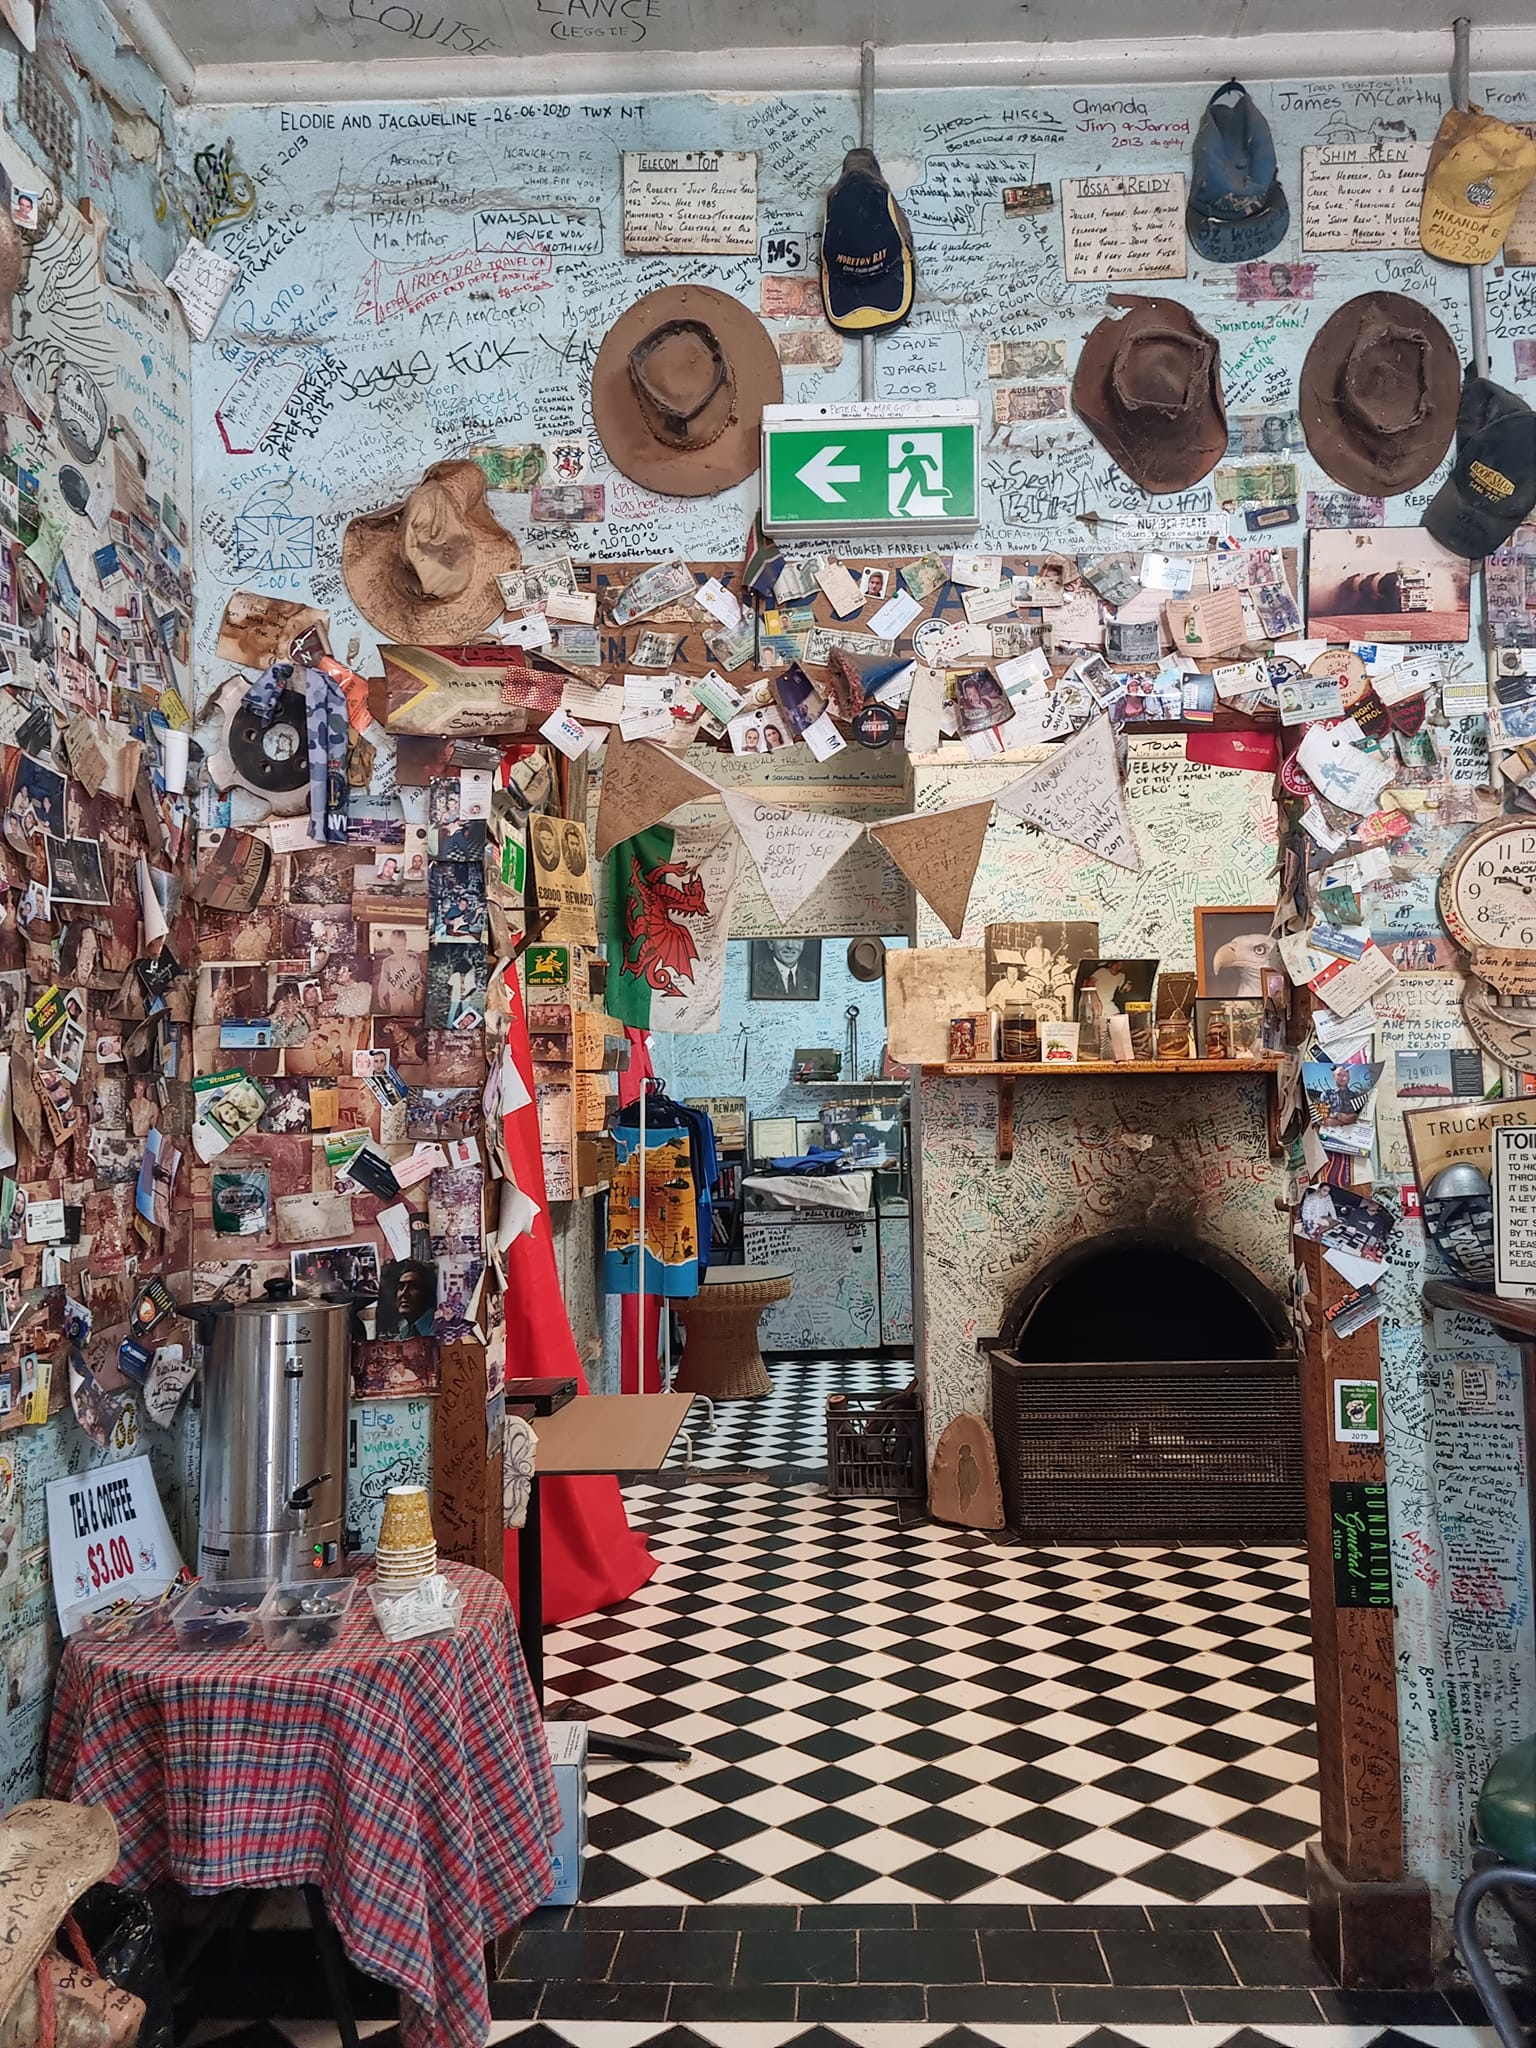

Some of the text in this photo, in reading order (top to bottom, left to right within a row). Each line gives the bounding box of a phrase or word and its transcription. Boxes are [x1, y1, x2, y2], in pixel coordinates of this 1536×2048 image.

[1280, 92, 1341, 112] James
[281, 111, 334, 130] ELODIE
[341, 111, 371, 129] AND
[378, 109, 477, 130] JACQUELINE
[1112, 137, 1143, 147] 2013
[482, 213, 560, 228] WALSALL
[506, 229, 584, 241] NEVER WON
[887, 337, 941, 350] JANE
[448, 337, 529, 375] FUCK
[886, 383, 936, 395] 2008
[1358, 708, 1382, 729] ATROL
[1499, 845, 1511, 860] 11
[1479, 861, 1494, 877] 10
[565, 891, 594, 907] REWARD
[1468, 883, 1480, 900] 9
[1477, 905, 1489, 923] 8
[1499, 922, 1508, 938] 7
[1521, 927, 1533, 944] 6
[1383, 1019, 1421, 1030] ANETA
[1382, 1031, 1451, 1043] FROM POLAND
[1427, 1112, 1527, 1138] TRUCKERS
[1446, 1146, 1484, 1158] SAFETY
[1509, 1153, 1529, 1162] IT IS
[1509, 1163, 1521, 1171] TO
[1509, 1184, 1529, 1193] IT IS
[1510, 1206, 1527, 1214] THE
[1510, 1219, 1529, 1227] NOT
[1510, 1229, 1522, 1238] BY
[1509, 1250, 1533, 1259] KEYS
[69, 1490, 88, 1540] TEA
[99, 1477, 138, 1532] COFFEE
[87, 1536, 136, 1589] $3.00
